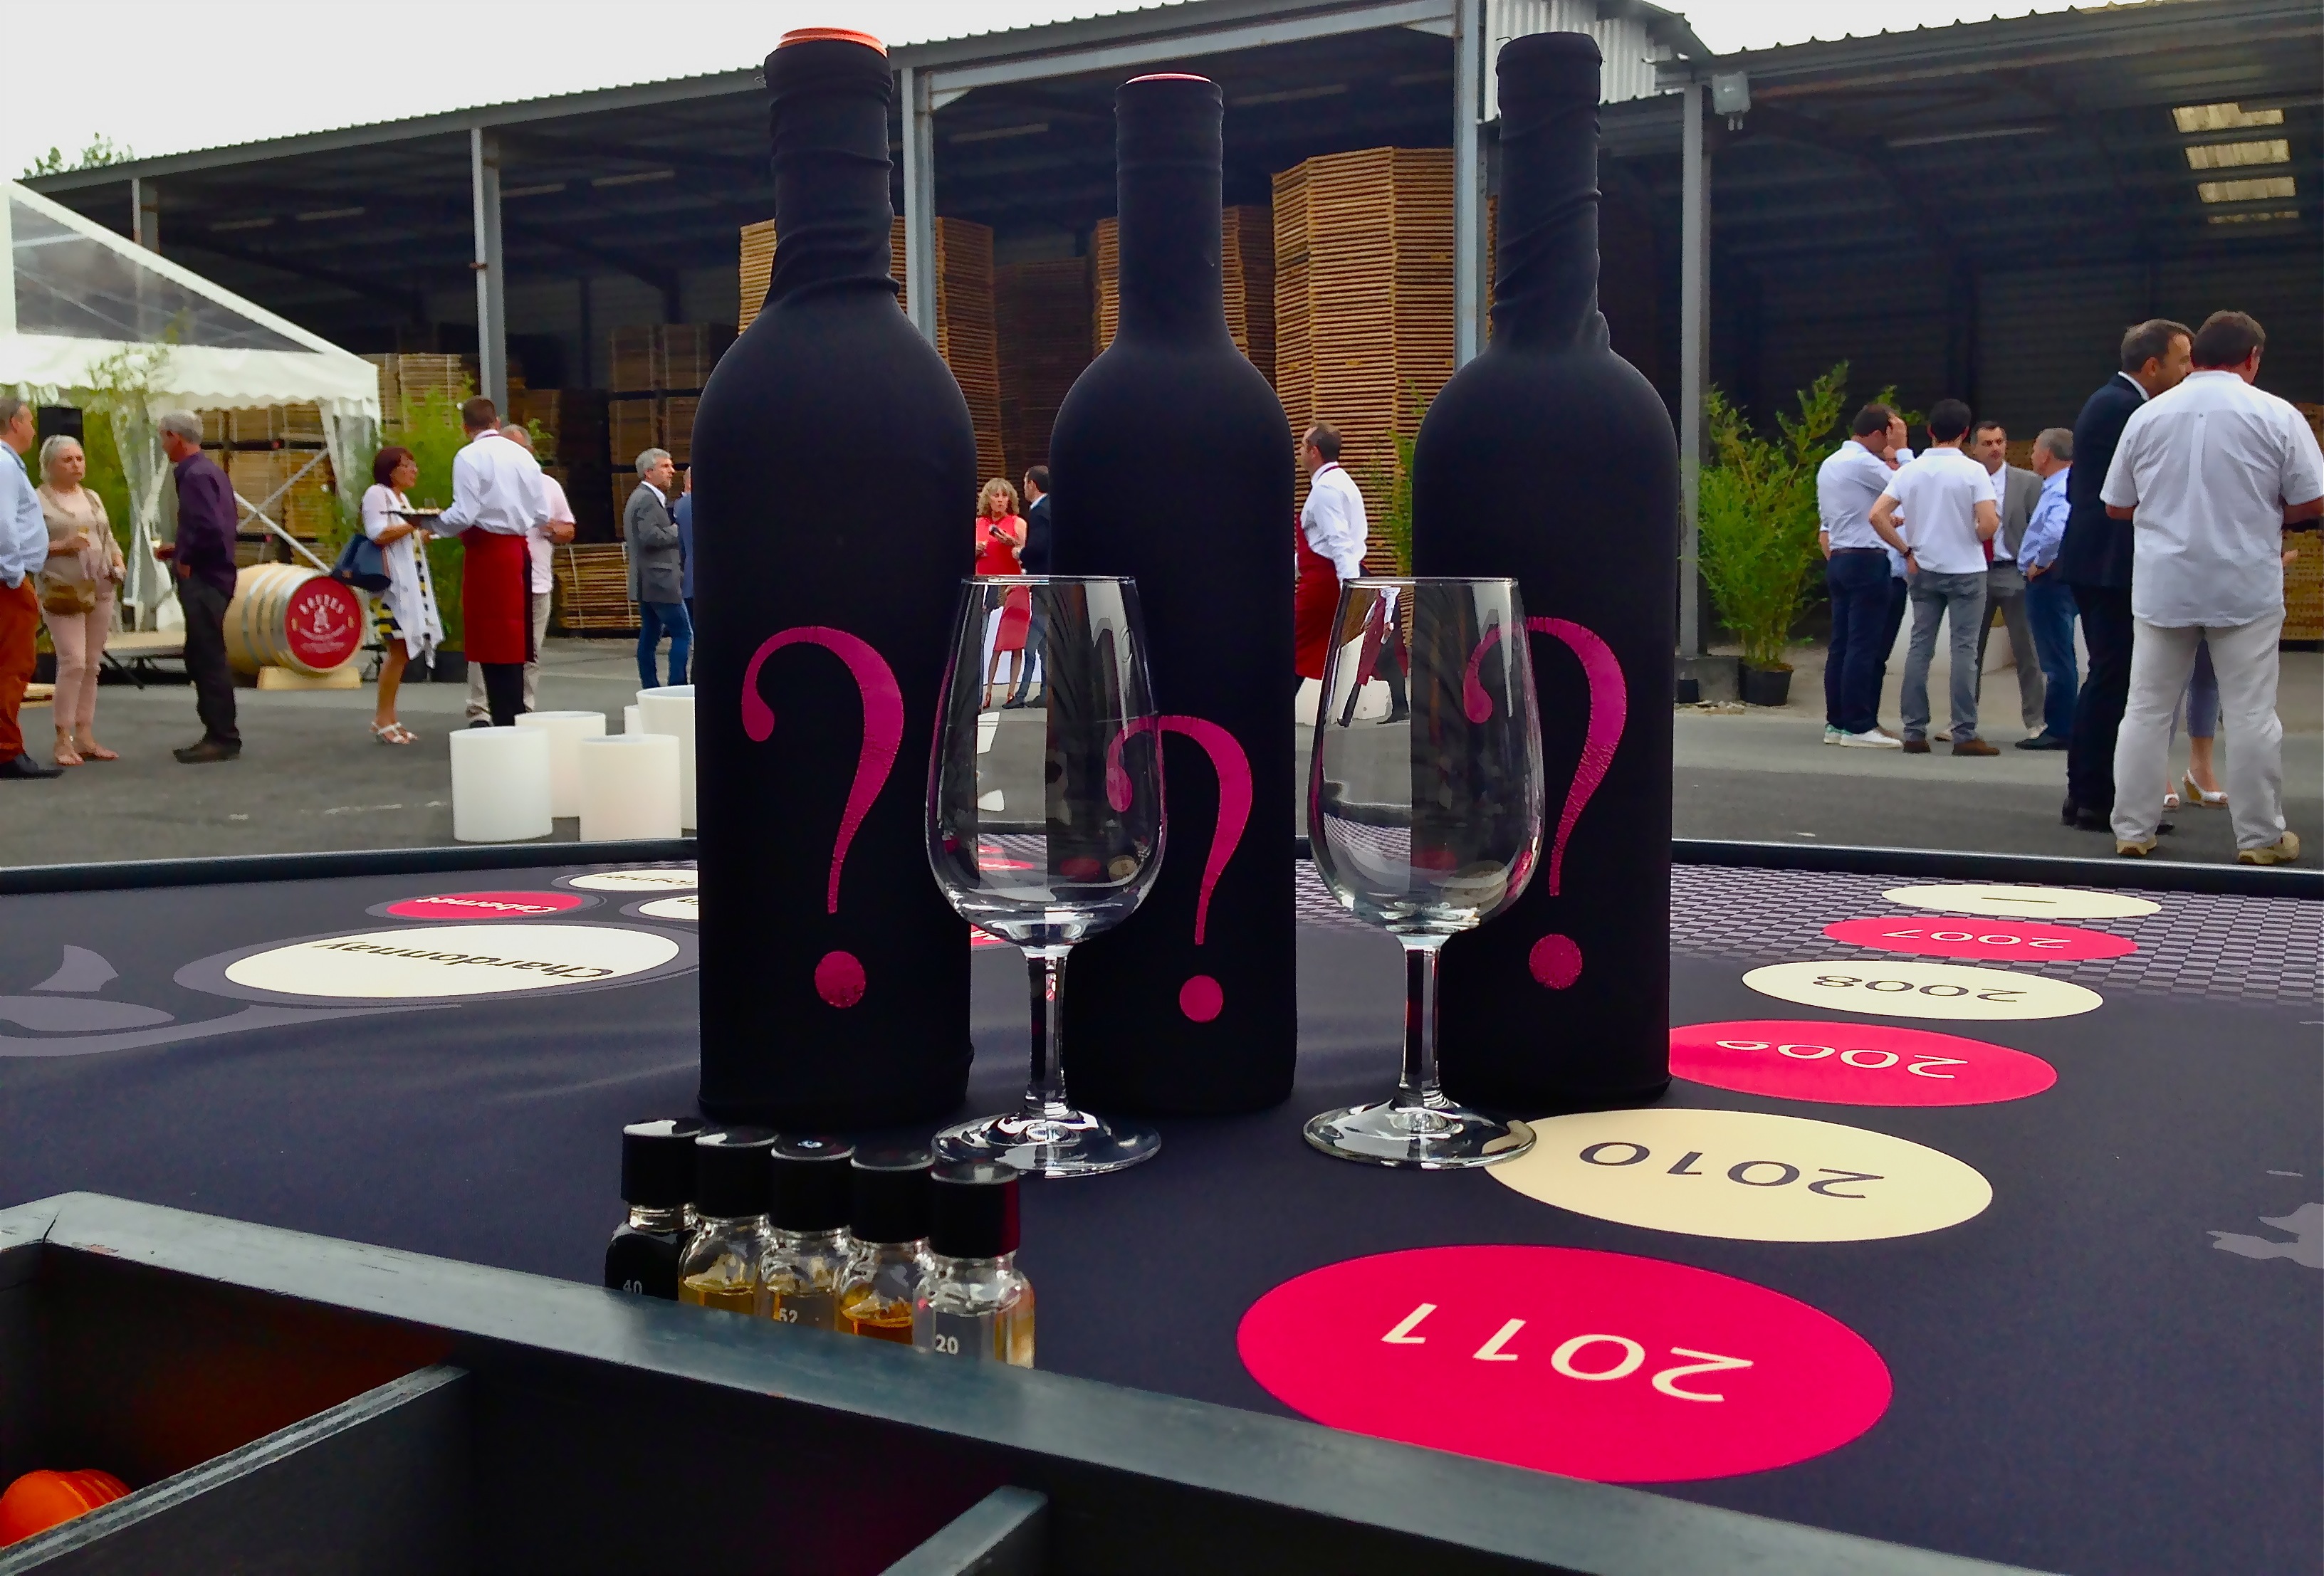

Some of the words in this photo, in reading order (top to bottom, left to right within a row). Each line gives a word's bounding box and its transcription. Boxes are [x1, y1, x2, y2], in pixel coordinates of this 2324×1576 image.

[1881, 929, 2071, 949] 2007
[311, 942, 614, 978] Chardonnay
[1812, 975, 2027, 1002] 2008
[1716, 1040, 1967, 1078] 2009
[1579, 1142, 1885, 1199] 2010
[936, 1333, 958, 1355] 20
[1383, 1303, 1753, 1401] 2011
